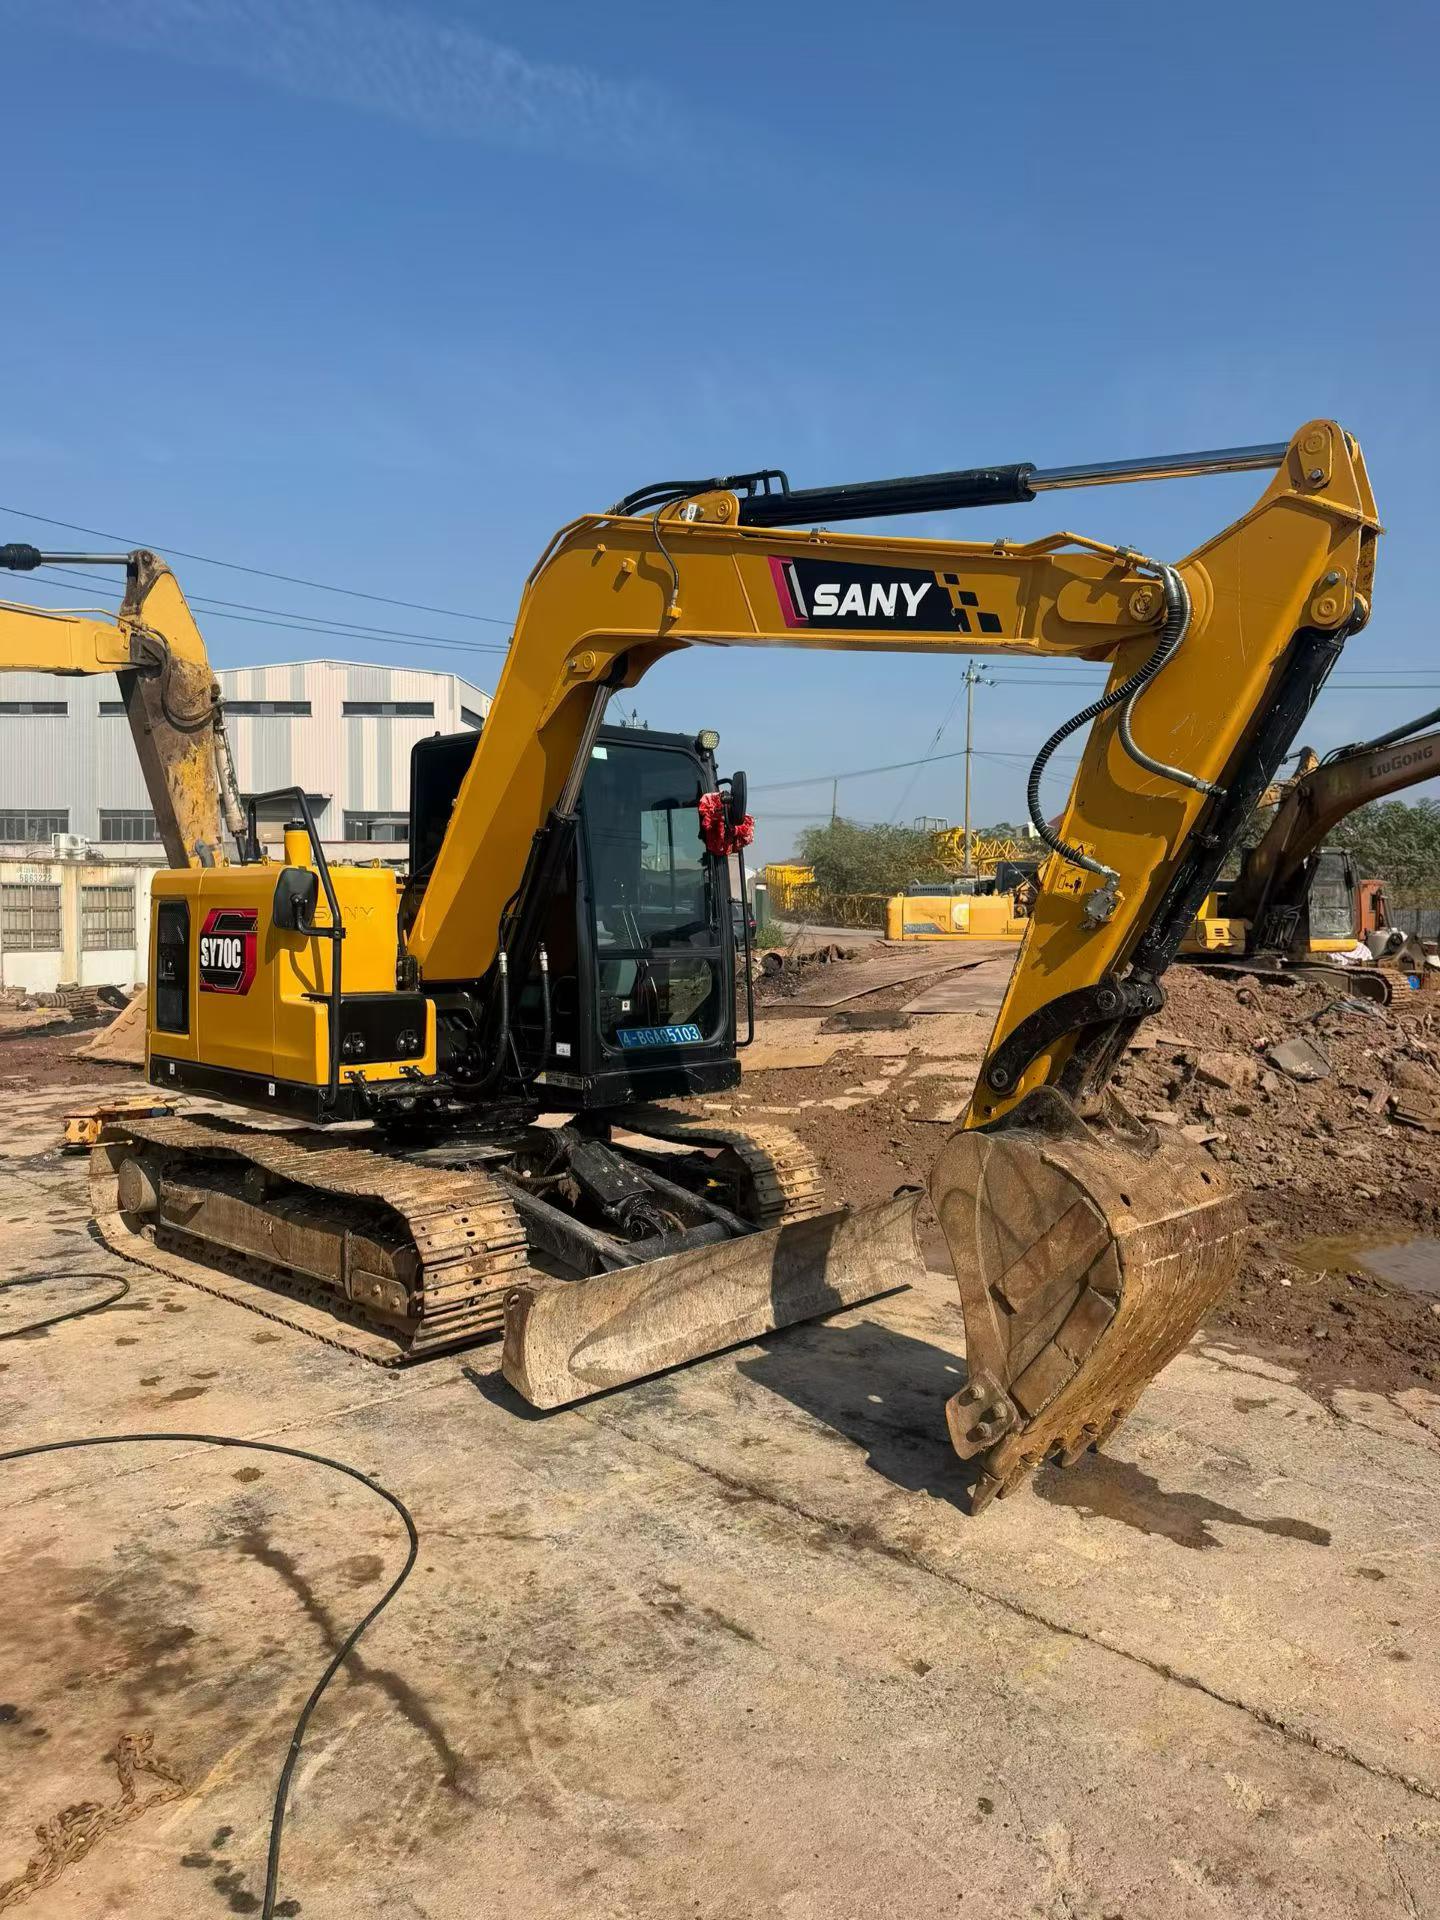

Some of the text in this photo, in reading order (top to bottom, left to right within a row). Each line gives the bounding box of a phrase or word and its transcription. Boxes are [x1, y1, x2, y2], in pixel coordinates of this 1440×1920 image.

[812, 583, 932, 617] SANY
[313, 905, 375, 921] SNY
[200, 937, 241, 968] SY70C
